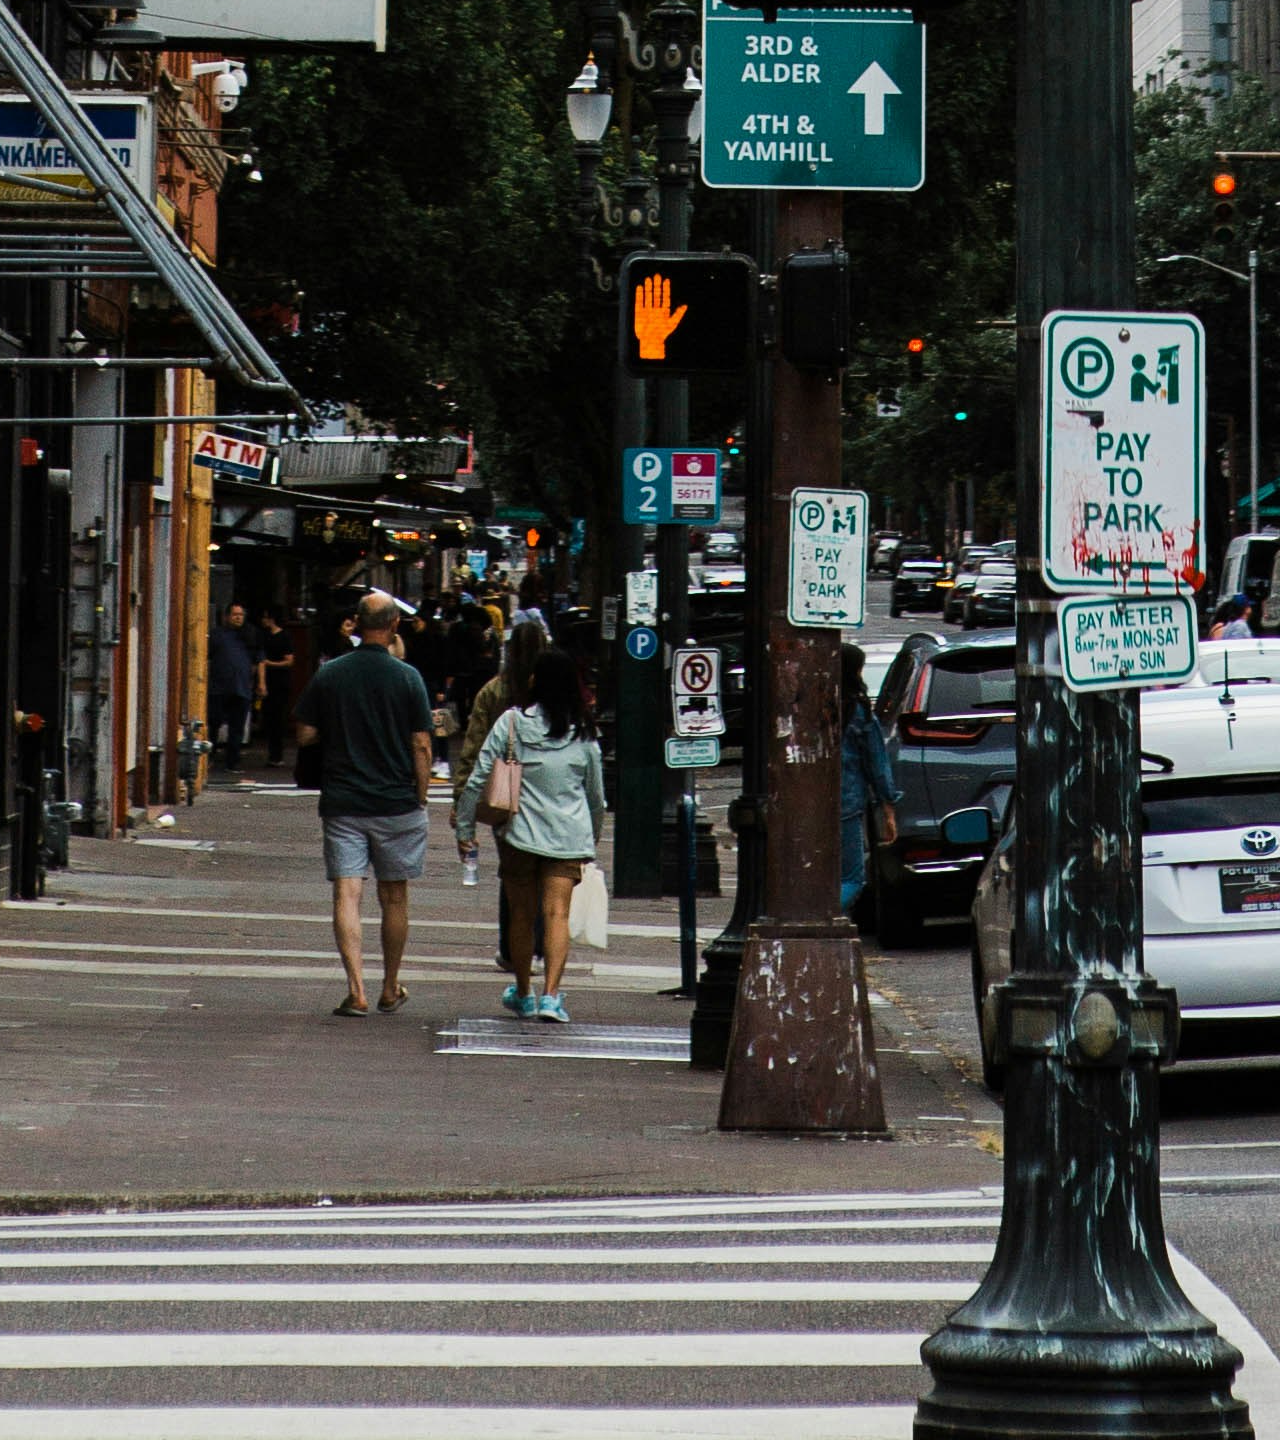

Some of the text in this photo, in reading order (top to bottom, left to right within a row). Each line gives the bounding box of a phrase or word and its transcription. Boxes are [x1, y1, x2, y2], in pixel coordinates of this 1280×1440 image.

[745, 35, 818, 56] 3RD &
[741, 63, 821, 83] ALDER
[742, 114, 815, 135] 4TH &
[723, 141, 833, 163] YAMHILL
[1077, 350, 1104, 386] P
[198, 435, 262, 466] ATM
[1095, 432, 1150, 462] PAY
[1103, 467, 1143, 497] TO
[639, 485, 658, 513] 2
[1084, 503, 1165, 533] PARK
[815, 548, 841, 565] PAY
[819, 565, 838, 582] TO
[808, 582, 847, 600] PARK
[1077, 606, 1174, 631] PAY METER
[1122, 627, 1180, 648] MON-SAT
[1139, 651, 1166, 670] SUN
